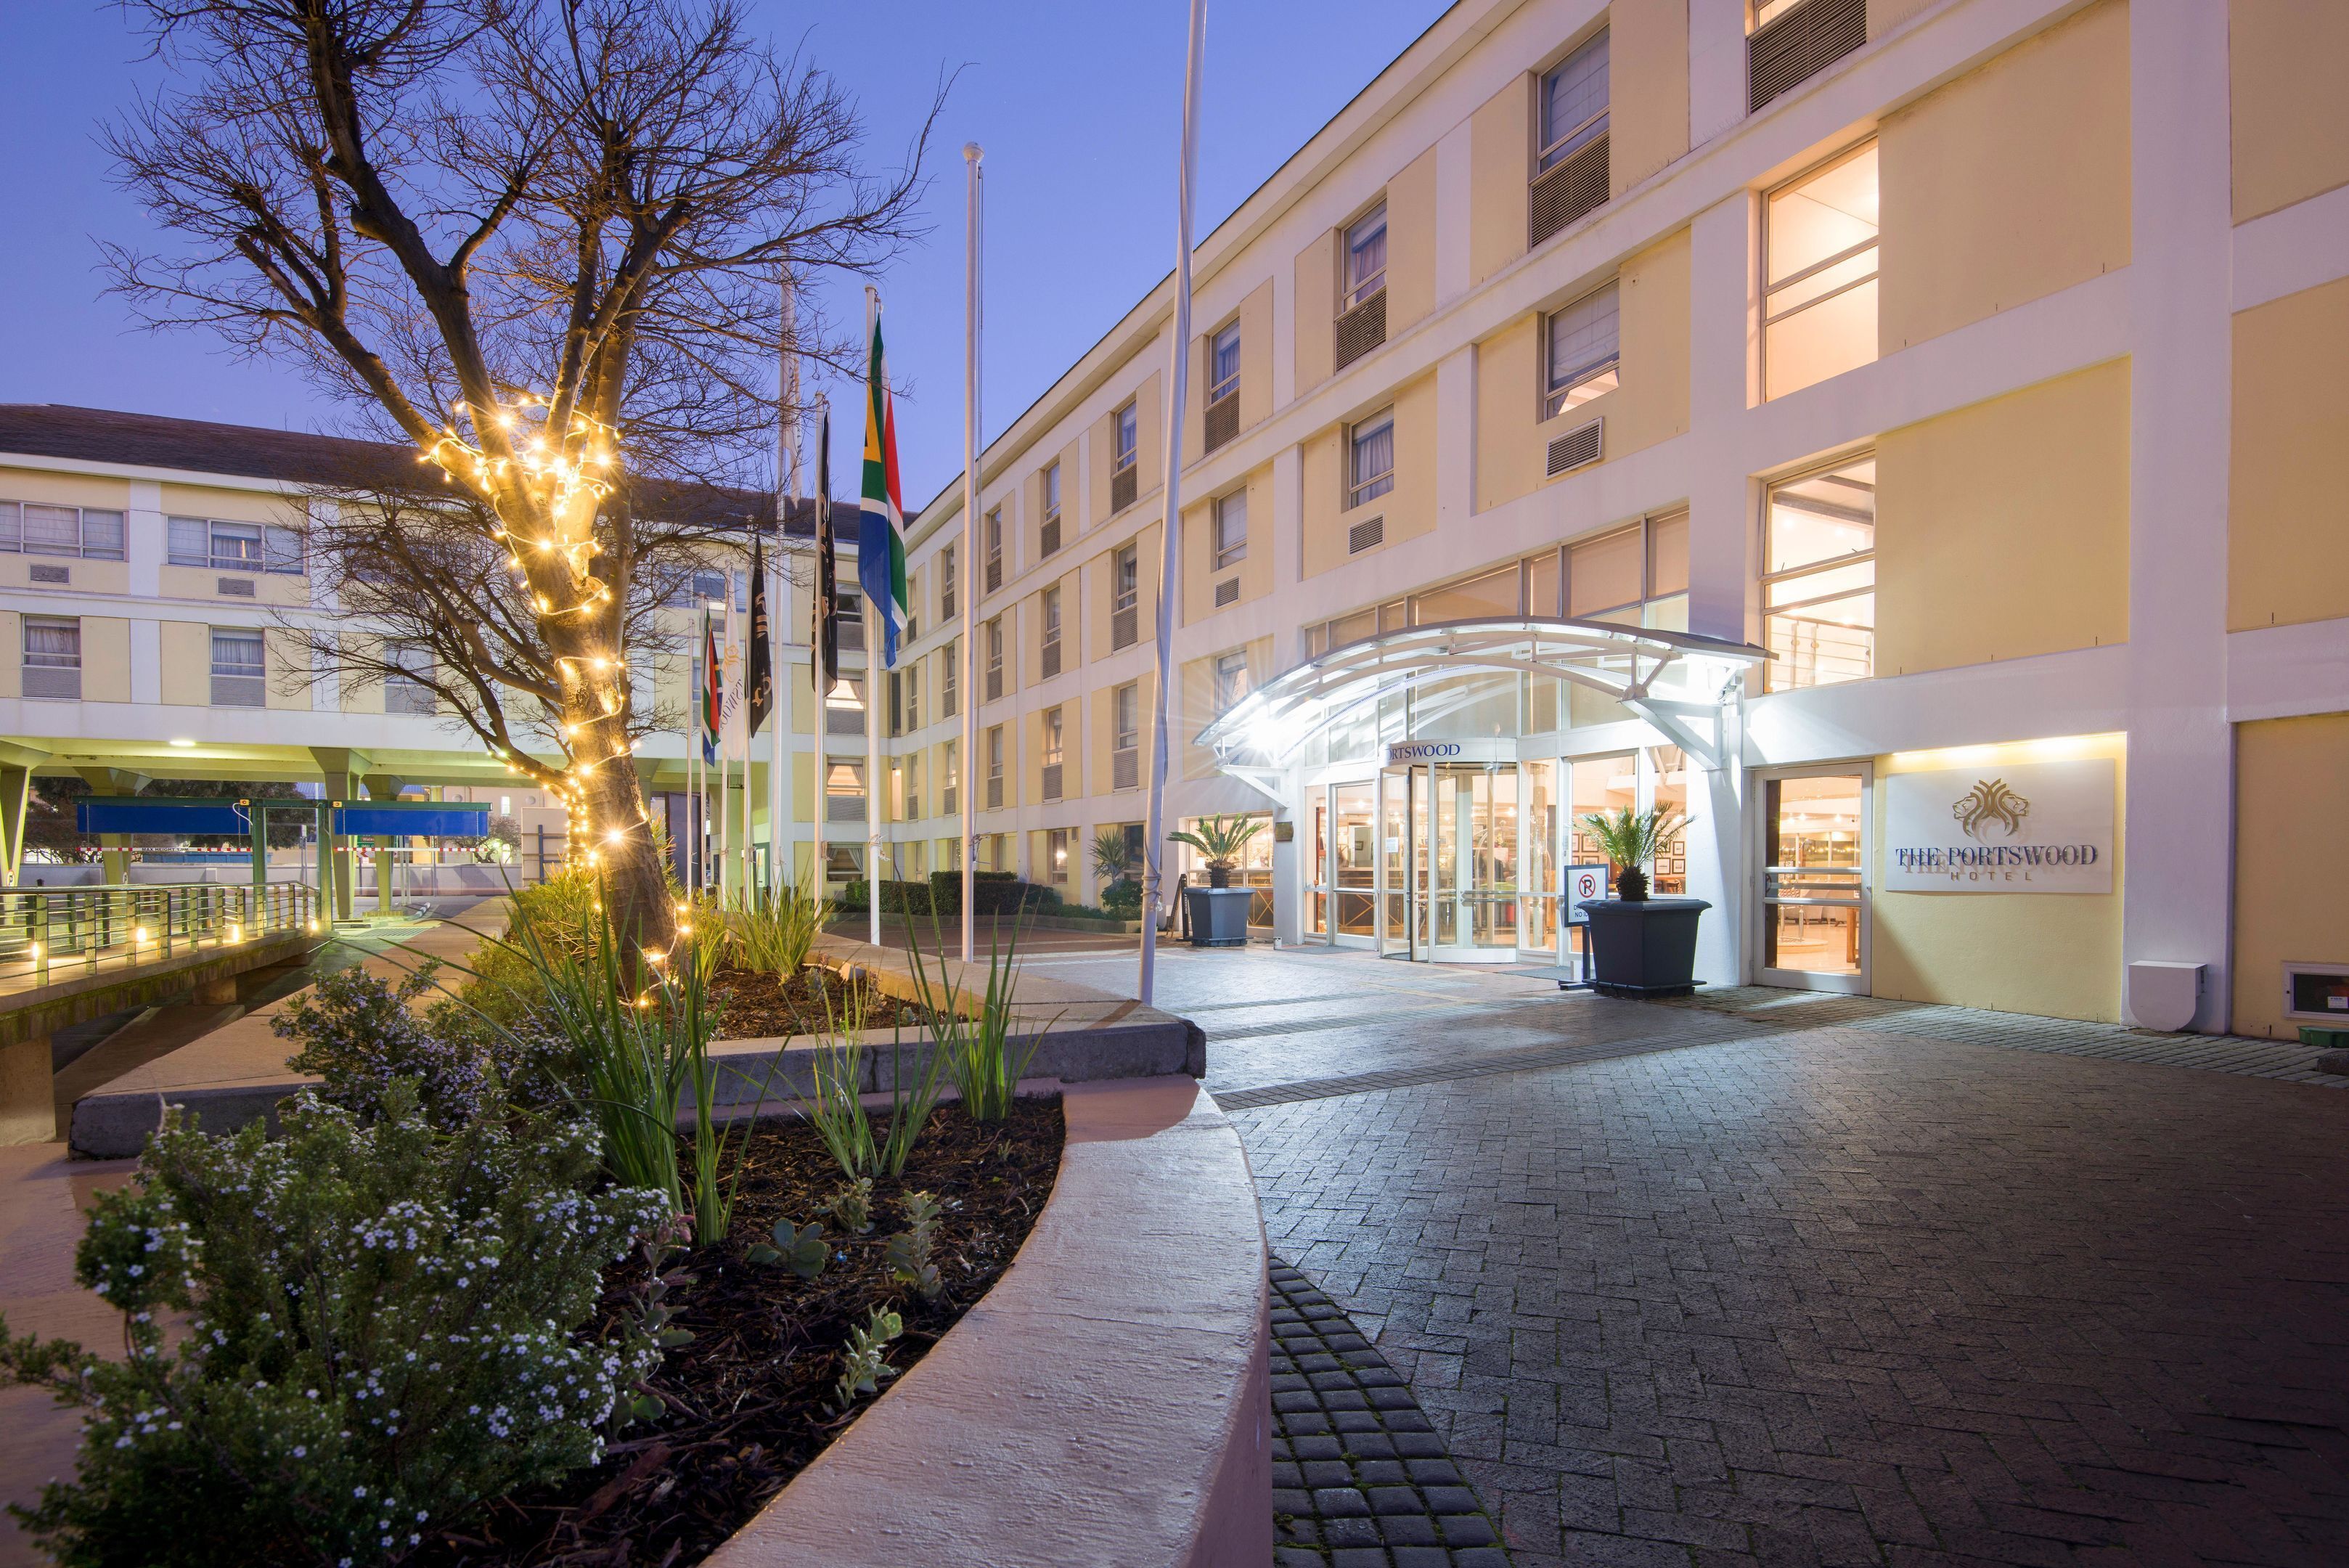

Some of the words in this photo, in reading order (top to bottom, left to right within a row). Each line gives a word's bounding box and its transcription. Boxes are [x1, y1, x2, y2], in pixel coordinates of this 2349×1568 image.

[1895, 847, 1939, 866] THE
[1947, 845, 2098, 866] PORTSWOOD
[1950, 871, 2033, 881] HOTEL
